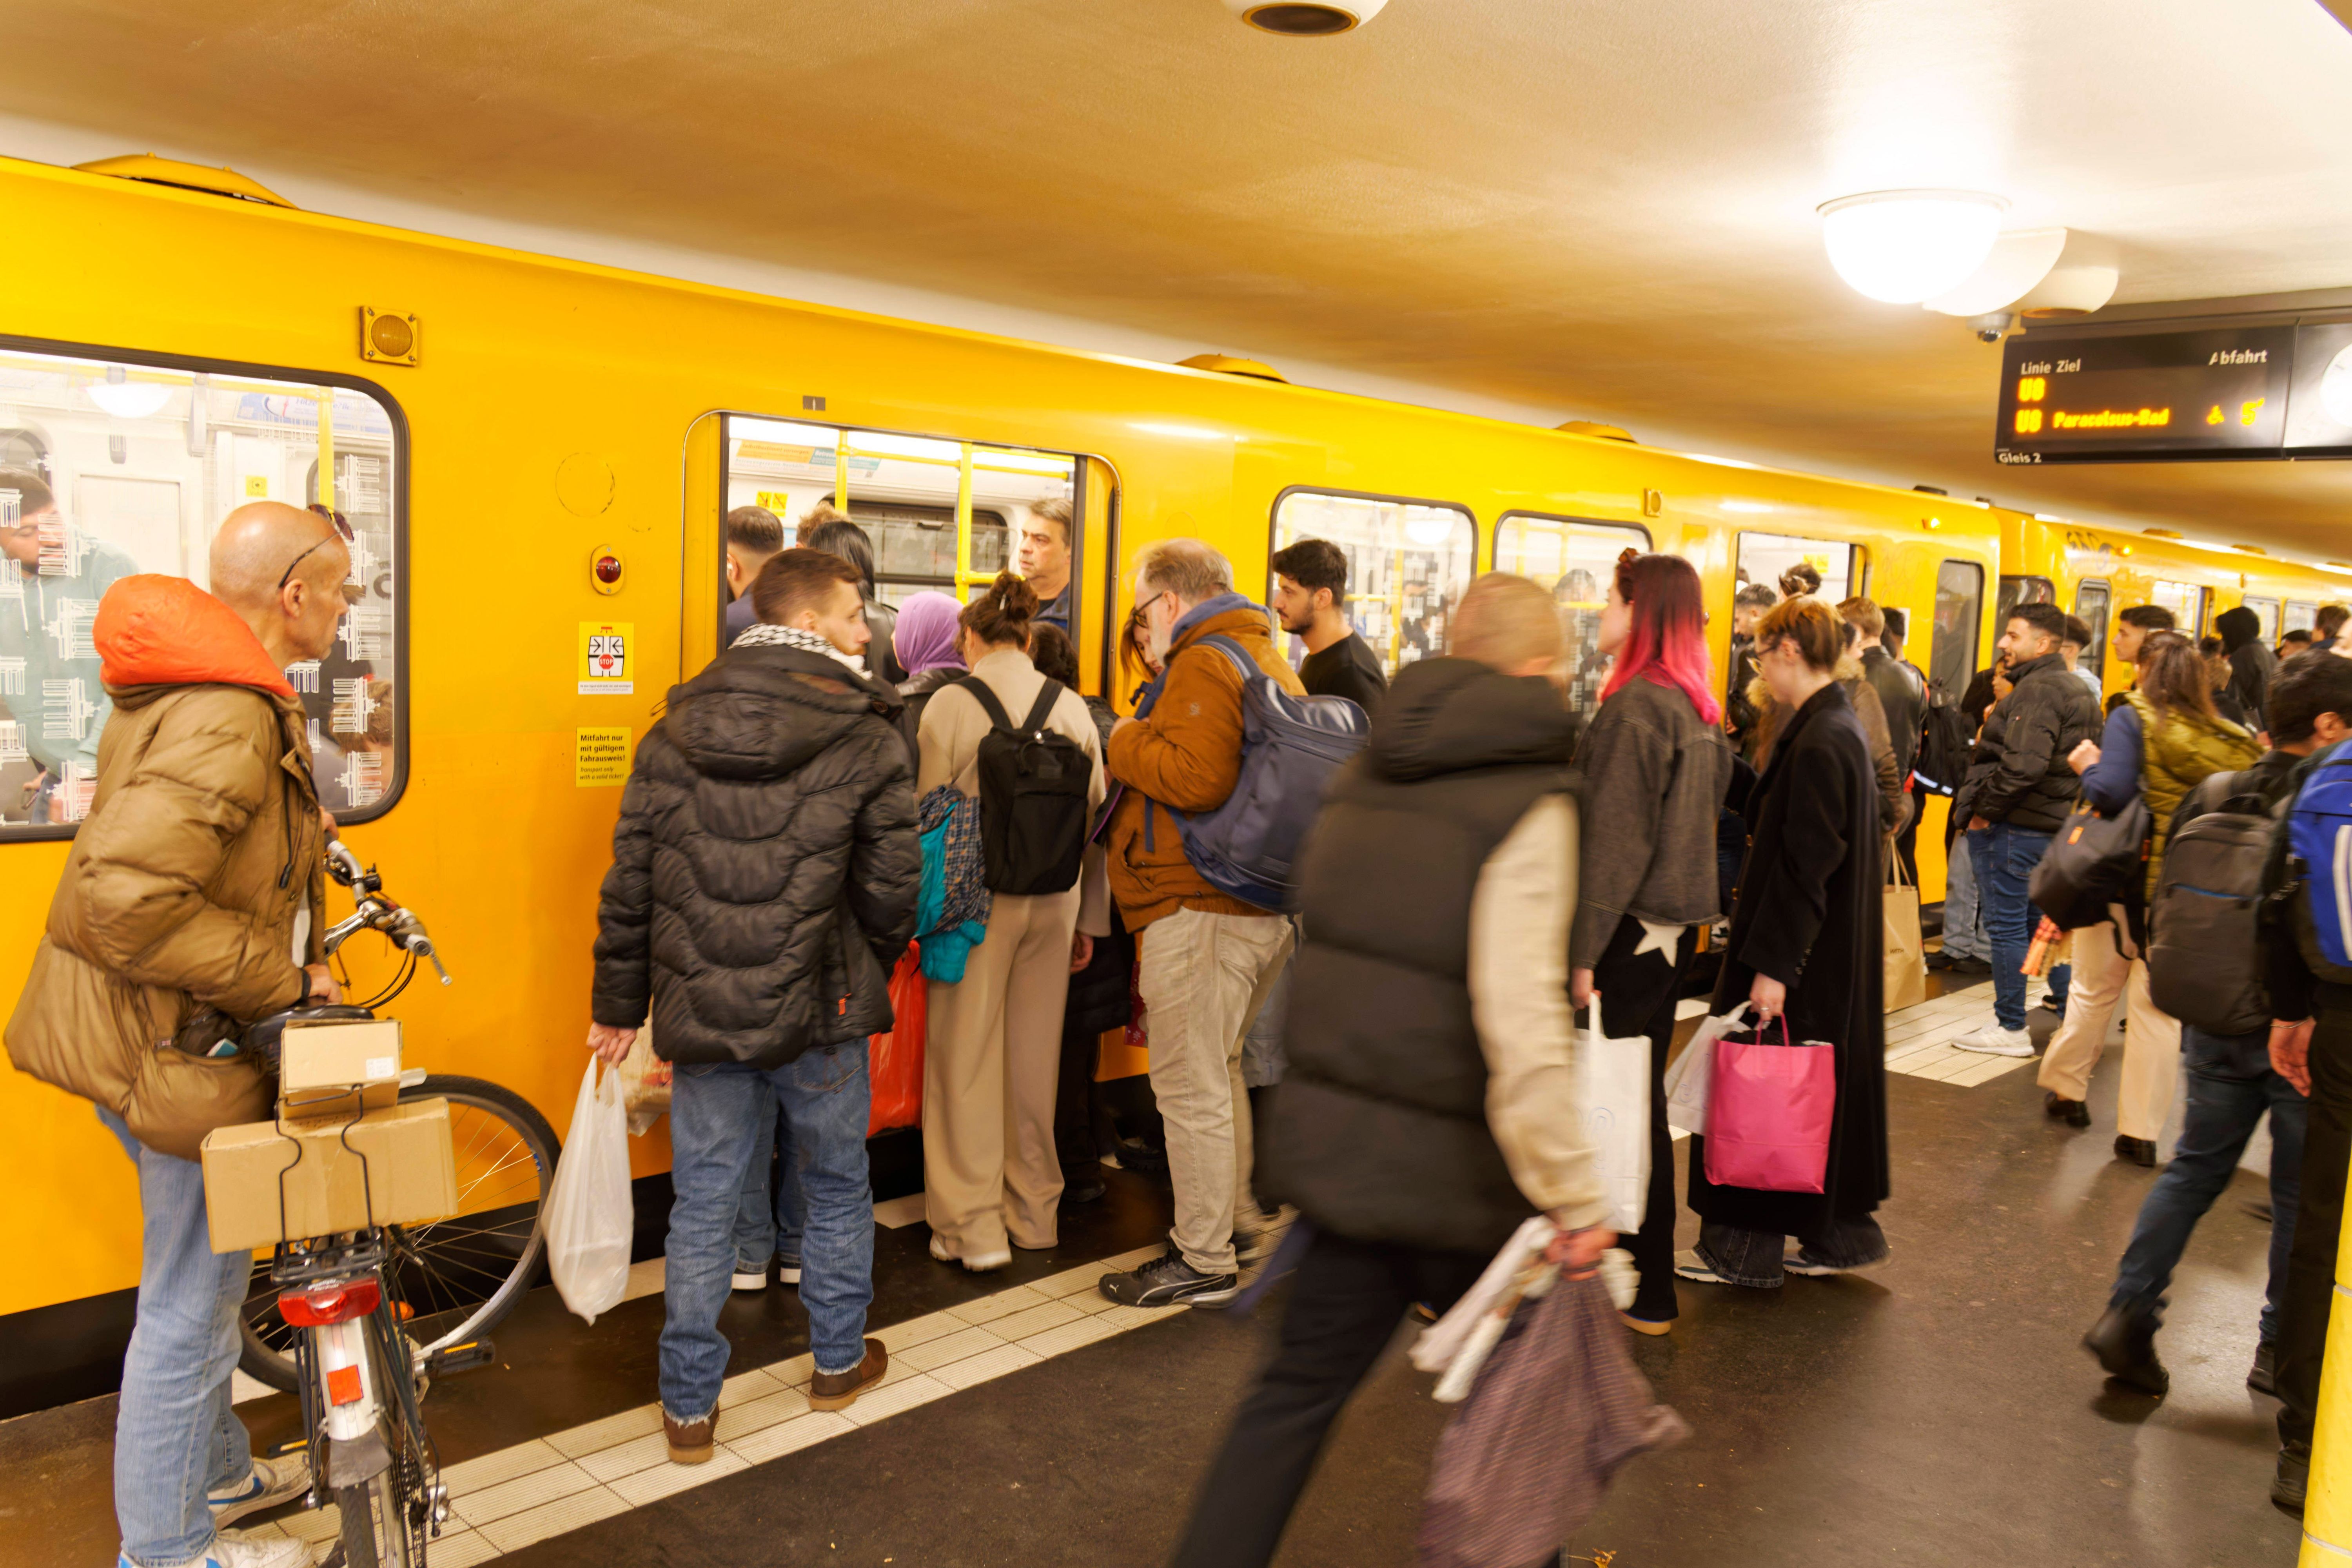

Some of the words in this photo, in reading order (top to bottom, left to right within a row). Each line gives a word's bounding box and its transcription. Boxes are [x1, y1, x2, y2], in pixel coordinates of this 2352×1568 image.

[2021, 361, 2051, 375] Linie
[2056, 358, 2081, 373] Ziel
[2209, 349, 2268, 366] Abfahrt
[2018, 377, 2046, 402] U8
[2015, 409, 2043, 433] U8
[2053, 408, 2169, 428] Paracelsus-Bad
[1999, 452, 2031, 463] Gleis
[2033, 452, 2042, 463] 2
[594, 744, 624, 753] gültigem
